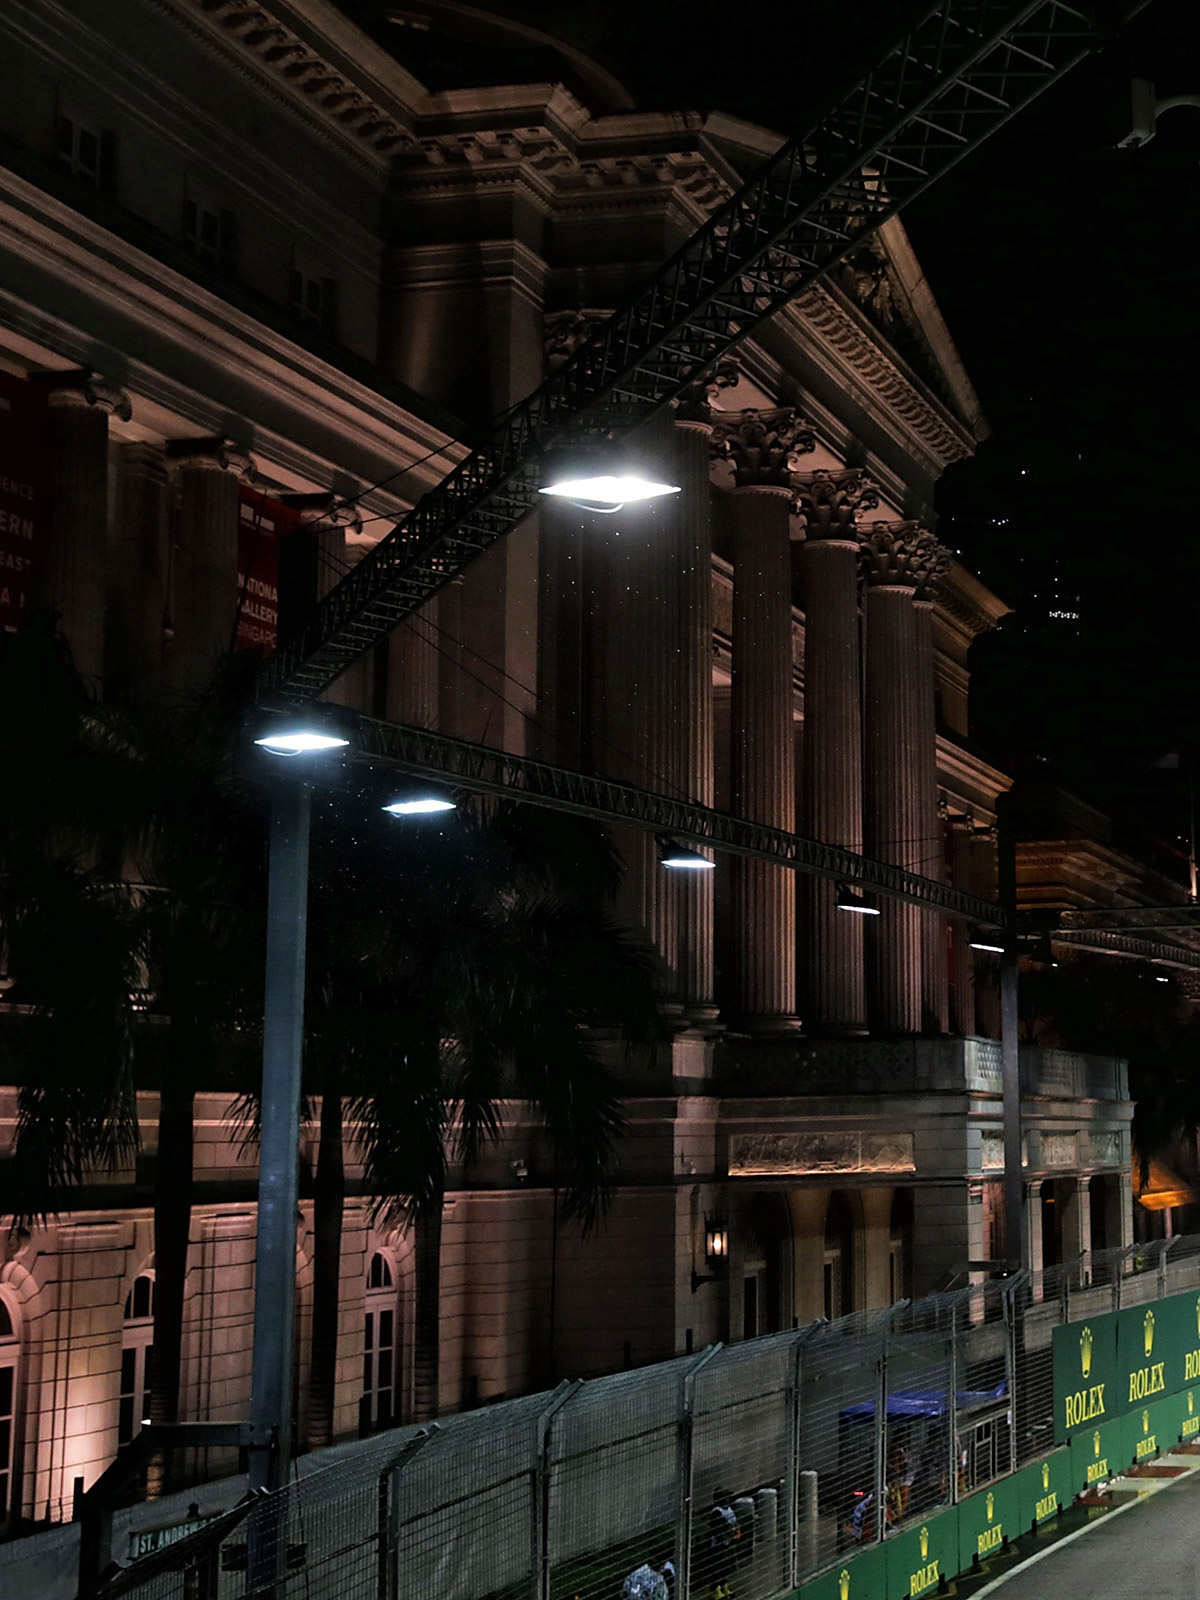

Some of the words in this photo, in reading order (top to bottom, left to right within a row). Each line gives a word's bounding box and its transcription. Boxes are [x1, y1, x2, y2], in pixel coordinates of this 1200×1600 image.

[1129, 1362, 1165, 1402] ROLEX
[1065, 1384, 1106, 1428] ROLEX
[1036, 1492, 1058, 1521] ROLEX
[977, 1524, 1002, 1554] ROLEX
[910, 1560, 939, 1597] ROLEX
